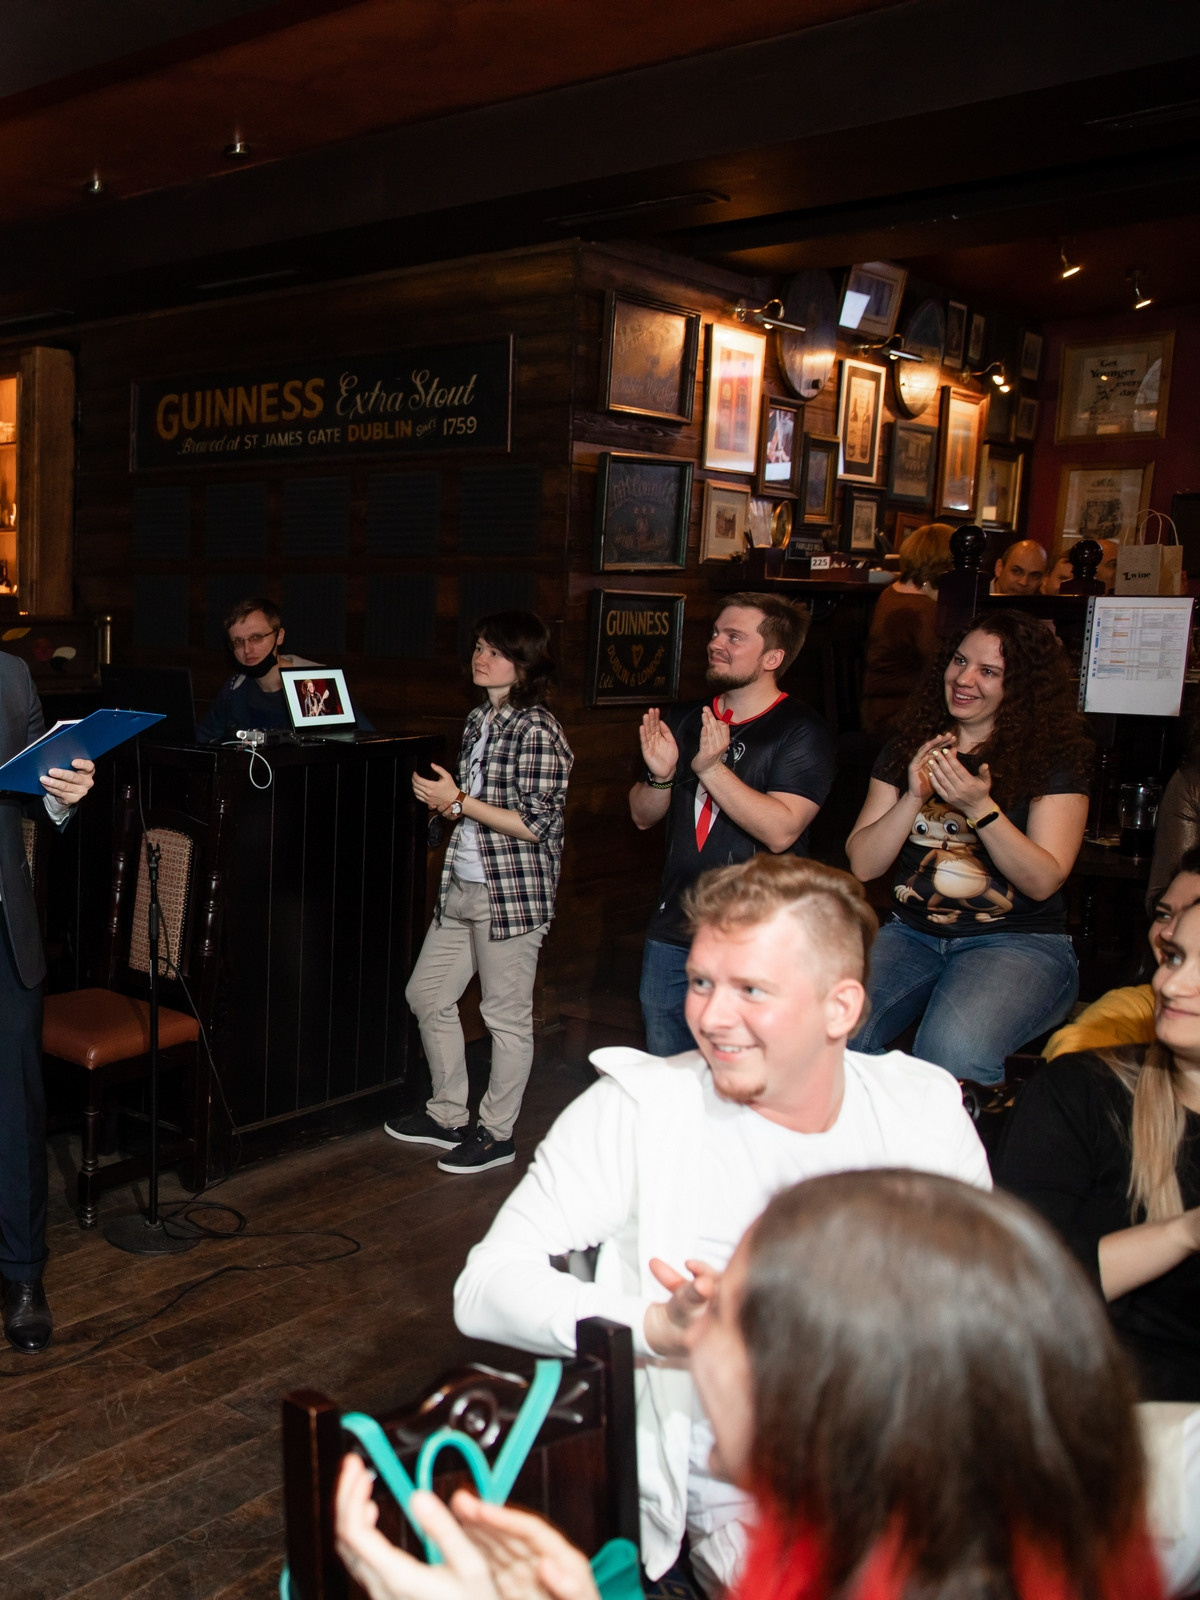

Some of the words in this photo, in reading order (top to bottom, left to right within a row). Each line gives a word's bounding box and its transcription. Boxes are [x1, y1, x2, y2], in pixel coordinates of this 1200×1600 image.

[156, 377, 325, 440] GUINNESS
[336, 370, 405, 419] Extra
[408, 368, 479, 411] Stout
[244, 434, 259, 449] ST
[261, 431, 302, 448] JAMES
[307, 428, 341, 445] GATE
[347, 420, 412, 442] DUBLIN
[443, 416, 478, 436] 1759
[812, 558, 828, 567] 225
[606, 610, 669, 636] GUINNESS
[607, 644, 630, 685] DUBLIN
